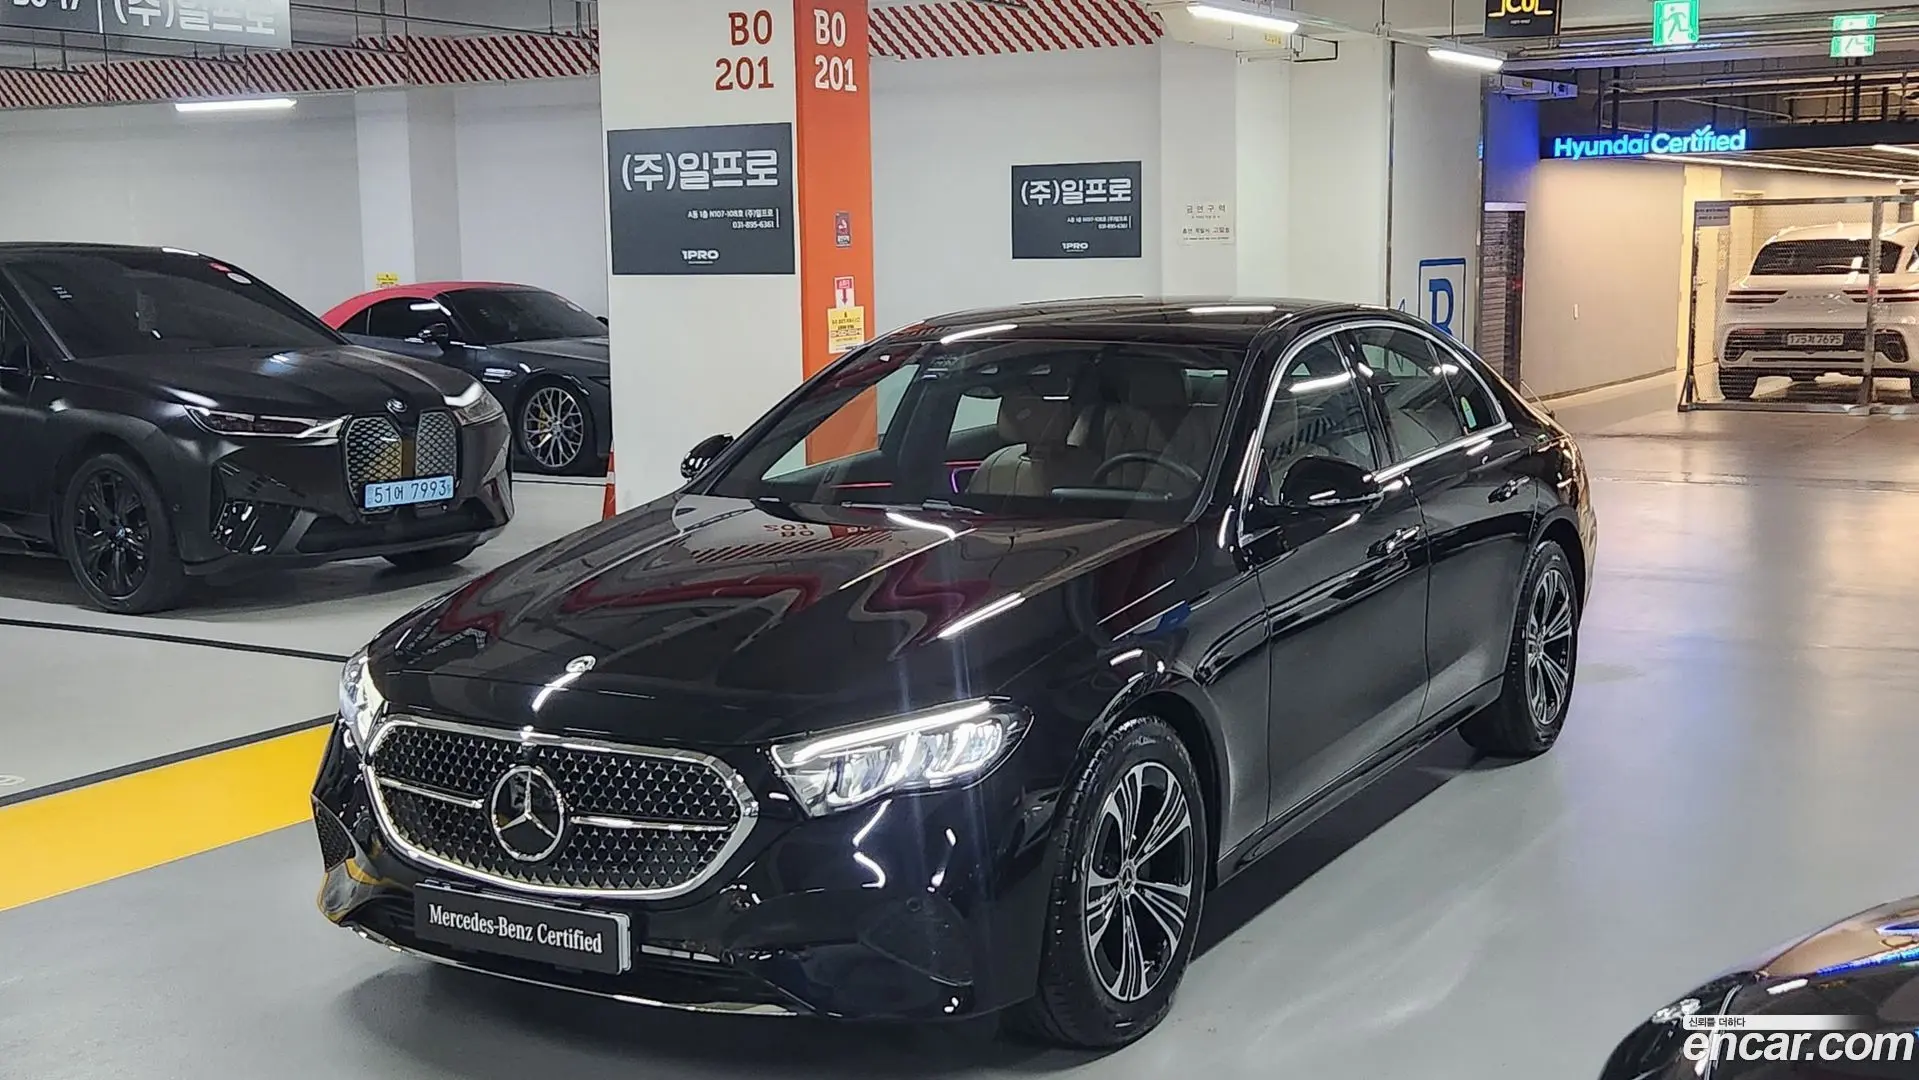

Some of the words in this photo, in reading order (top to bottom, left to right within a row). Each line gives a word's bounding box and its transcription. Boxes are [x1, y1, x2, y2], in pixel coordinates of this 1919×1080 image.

[715, 56, 774, 90] 201
[814, 54, 857, 92] 201
[1554, 134, 1649, 160] Hyundai
[1651, 125, 1746, 154] Certified
[621, 149, 778, 191] (주)일프로
[1021, 178, 1131, 205] (주)일프로
[374, 485, 404, 503] 51어
[411, 480, 446, 499] 7993
[429, 904, 534, 942] Mercedes-Benz
[537, 923, 602, 954] Certified
